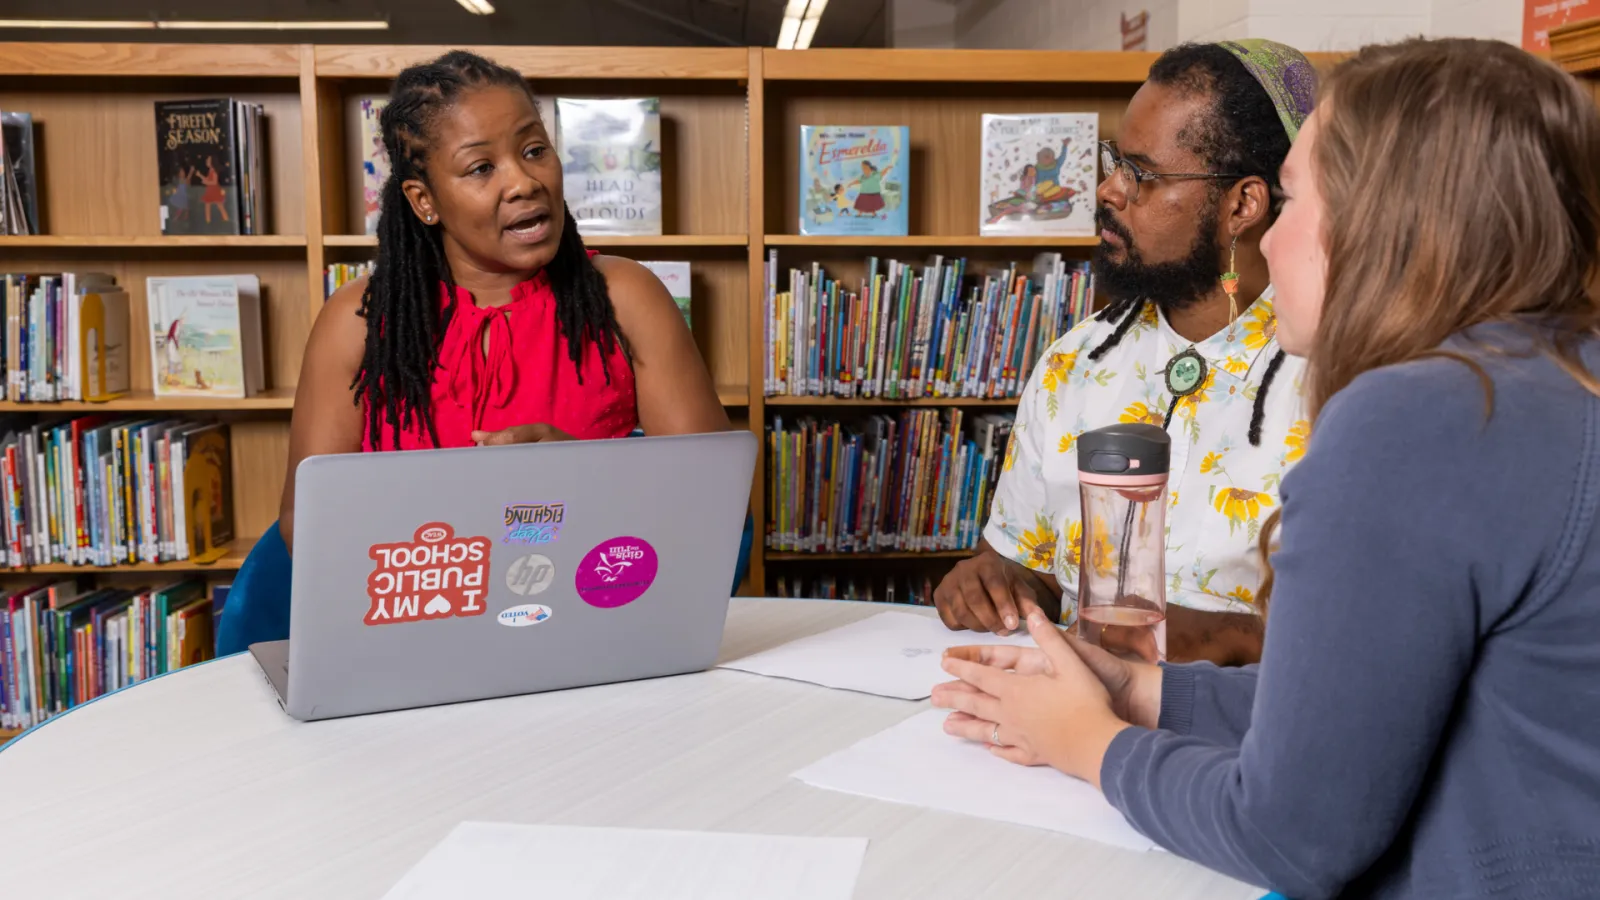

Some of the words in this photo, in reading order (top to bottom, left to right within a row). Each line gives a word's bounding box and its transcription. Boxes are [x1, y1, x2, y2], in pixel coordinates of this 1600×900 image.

[166, 112, 217, 129] FIREFLY
[166, 127, 221, 150] SEASON
[585, 179, 635, 192] HEAD
[576, 207, 646, 221] CLOUDS
[504, 504, 564, 526] FIGHTING
[509, 524, 552, 544] Keep
[376, 541, 485, 569] SCHOOL
[609, 545, 631, 554] run
[616, 550, 645, 560] Girls
[374, 564, 484, 595] PUBLIC
[370, 594, 420, 621] MY
[461, 589, 482, 612] I
[501, 610, 529, 619] VOTED
